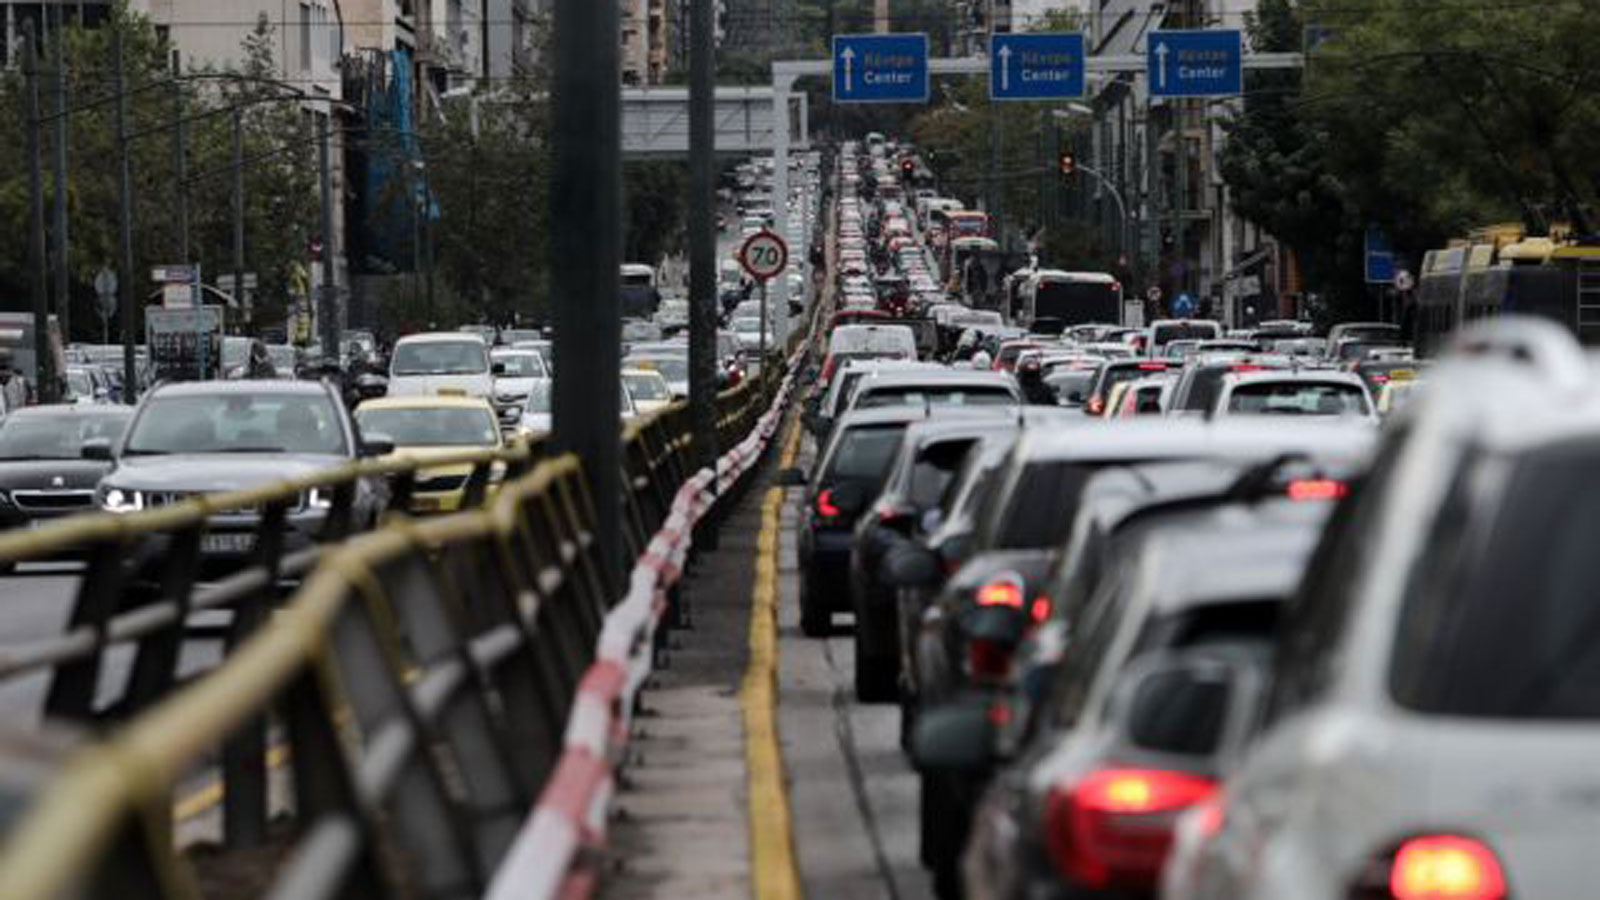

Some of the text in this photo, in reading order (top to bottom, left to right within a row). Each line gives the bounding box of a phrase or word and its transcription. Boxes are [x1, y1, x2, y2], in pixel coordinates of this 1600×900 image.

[864, 71, 912, 85] Center
[1022, 69, 1070, 82] Center
[1179, 66, 1226, 79] Center
[752, 246, 778, 265] 70
